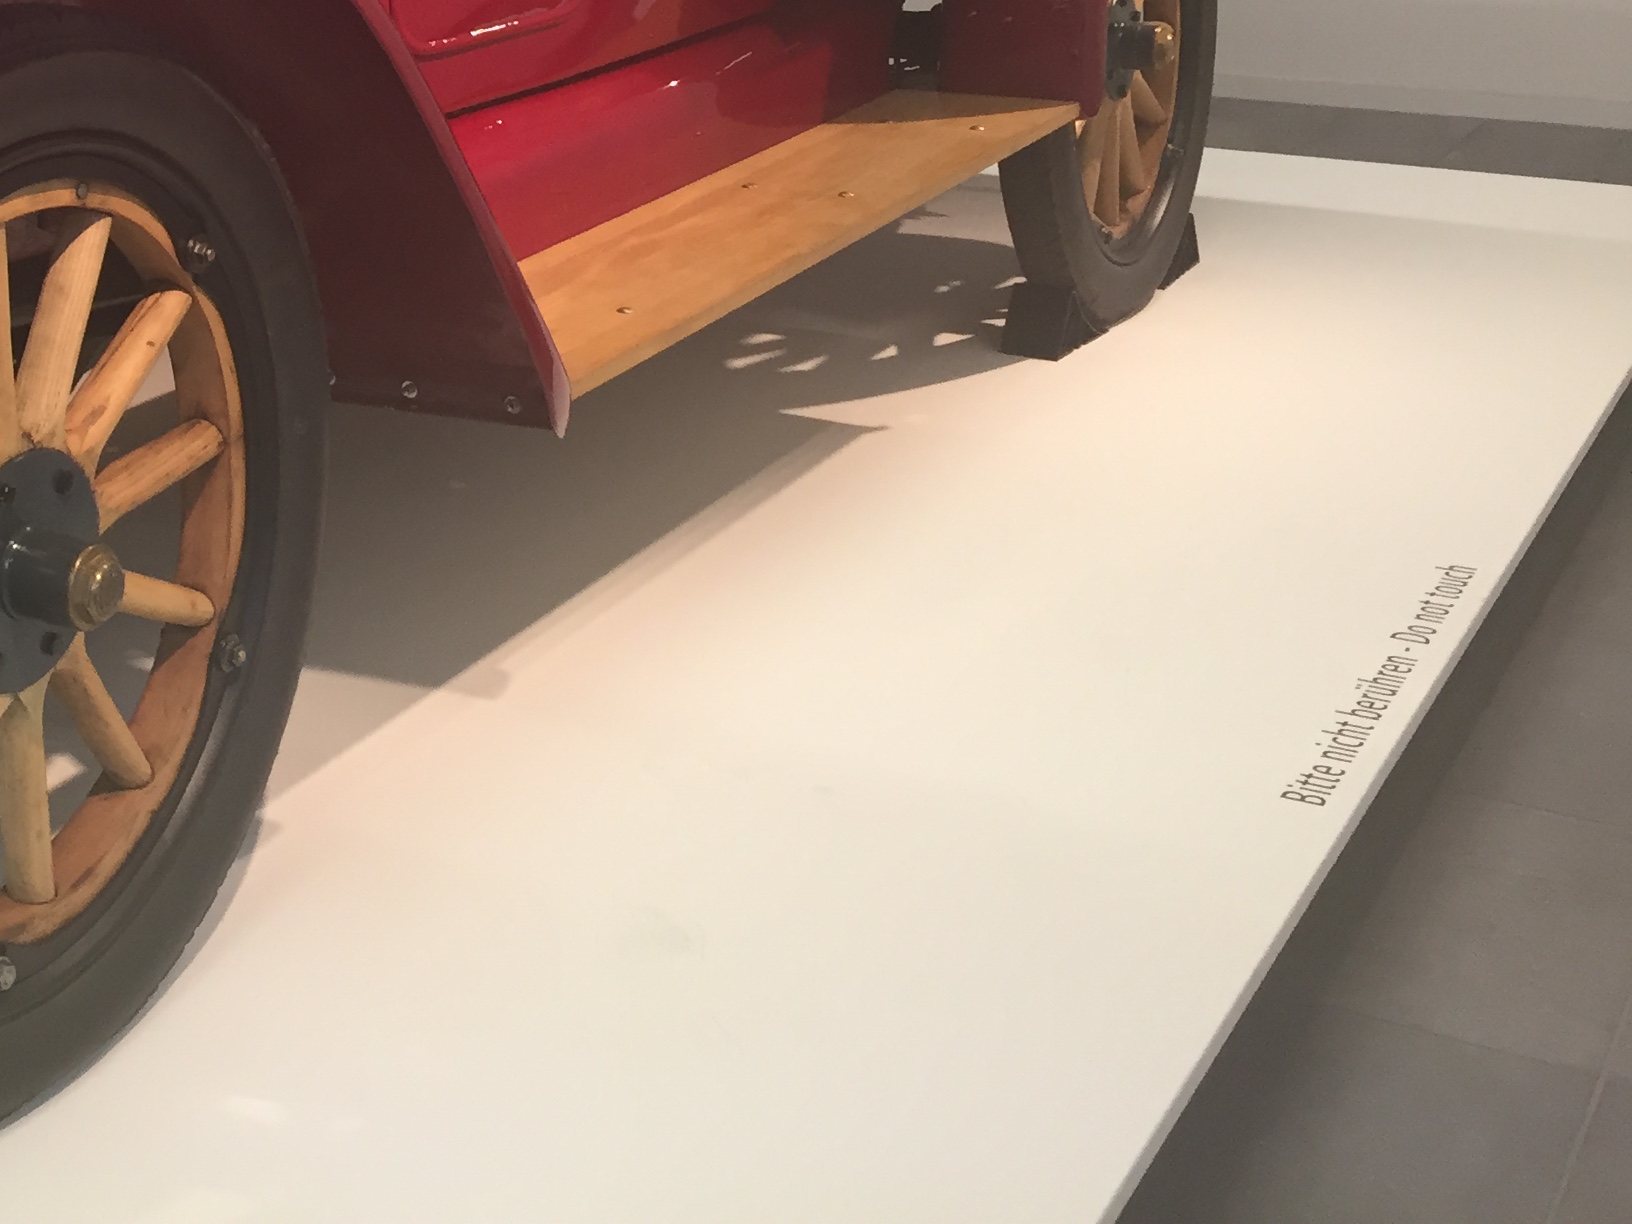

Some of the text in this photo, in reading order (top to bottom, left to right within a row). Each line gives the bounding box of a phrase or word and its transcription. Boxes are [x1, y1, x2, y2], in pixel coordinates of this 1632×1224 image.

[1424, 564, 1478, 600] touch
[1413, 599, 1455, 625] not
[1389, 624, 1438, 646] Do
[1334, 655, 1419, 721] berühren
[1314, 720, 1376, 764] nicht
[1279, 764, 1347, 807] Bitte
